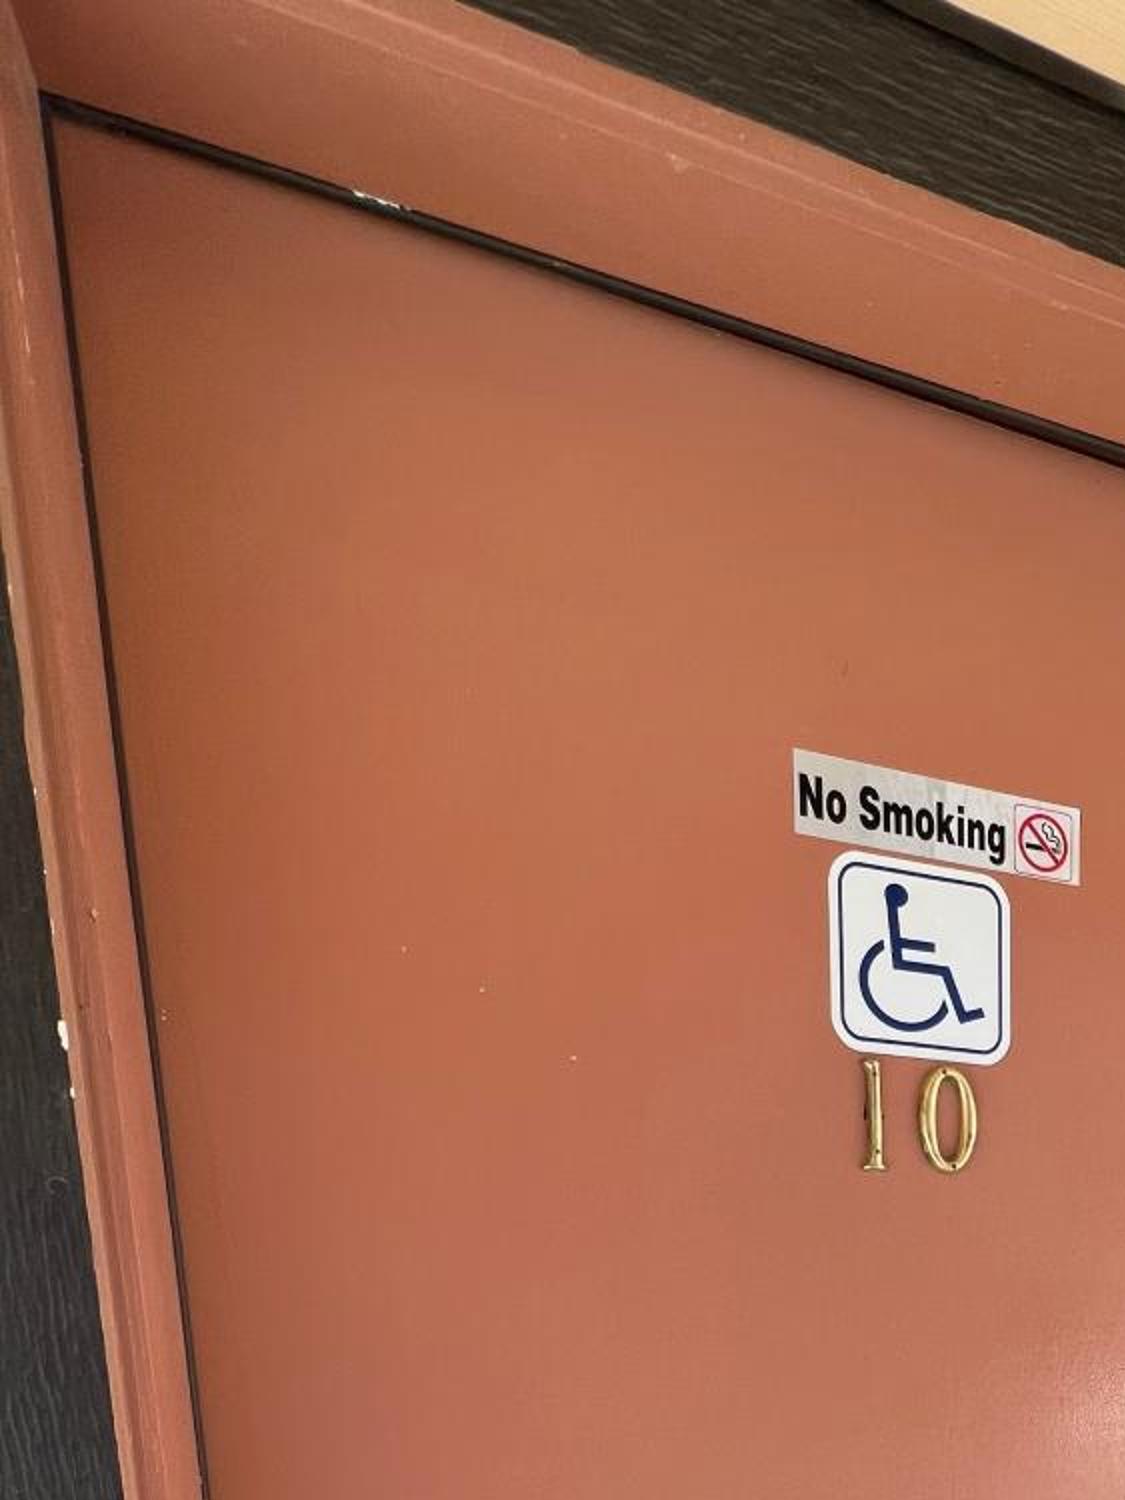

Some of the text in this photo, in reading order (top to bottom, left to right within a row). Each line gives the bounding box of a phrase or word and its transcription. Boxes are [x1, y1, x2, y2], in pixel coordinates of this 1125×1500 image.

[798, 773, 1006, 865] No Smoking
[863, 1058, 978, 1174] 10
